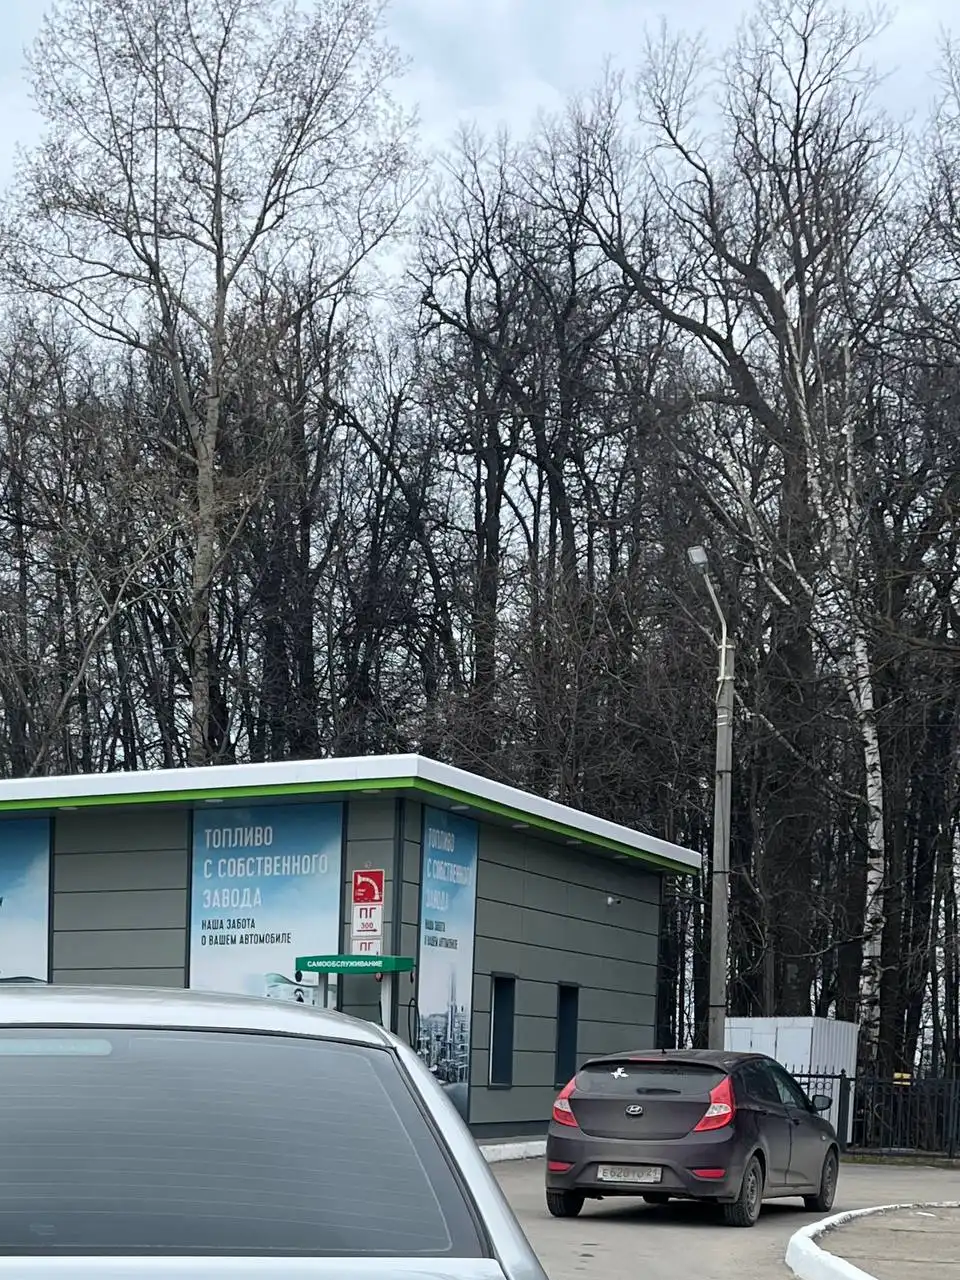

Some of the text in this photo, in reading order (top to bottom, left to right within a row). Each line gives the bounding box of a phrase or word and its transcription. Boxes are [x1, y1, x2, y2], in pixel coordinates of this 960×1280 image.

[204, 826, 273, 849] ТОПЛИВО
[203, 854, 328, 879] С СОБСТВЕННОГО
[202, 887, 262, 909] ЗАВОДА
[359, 907, 376, 919] ПГ
[201, 918, 256, 930] НАША ЗАБОТА
[201, 932, 292, 946] О ВАШЕМ АВТОМОБИЛЕ
[359, 942, 374, 951] ПГ
[307, 960, 383, 968] САМООБСЛУЖИВАНИЕ
